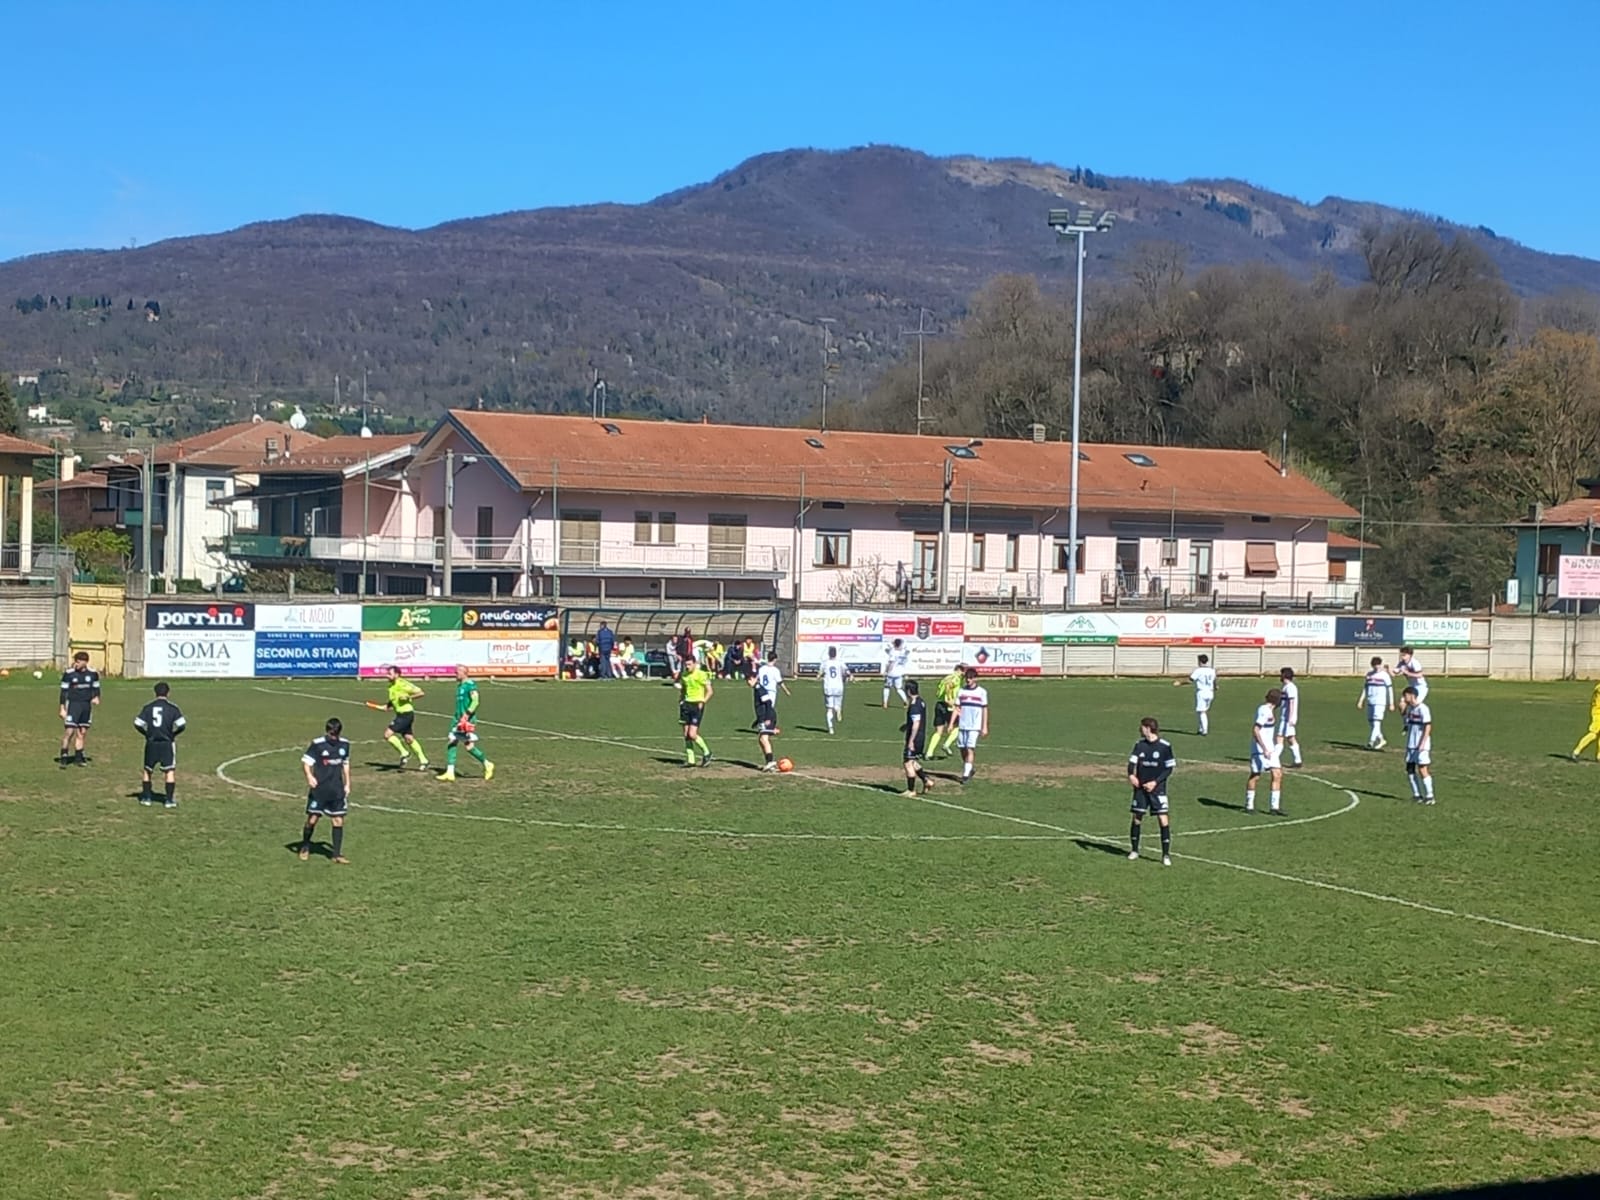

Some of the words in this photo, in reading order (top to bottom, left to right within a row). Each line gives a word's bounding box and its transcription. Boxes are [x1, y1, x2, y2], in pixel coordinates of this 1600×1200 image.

[157, 606, 245, 628] porrini
[480, 610, 544, 622] newGraphic
[857, 616, 879, 631] sky
[1405, 620, 1429, 630] EDIL
[1432, 620, 1469, 631] RANDO
[168, 641, 231, 659] SOMA
[256, 647, 310, 658] SECONDA
[312, 647, 358, 658] STRADA
[993, 648, 1032, 664] Pregis
[829, 666, 837, 678] 6
[152, 707, 163, 727] 5
